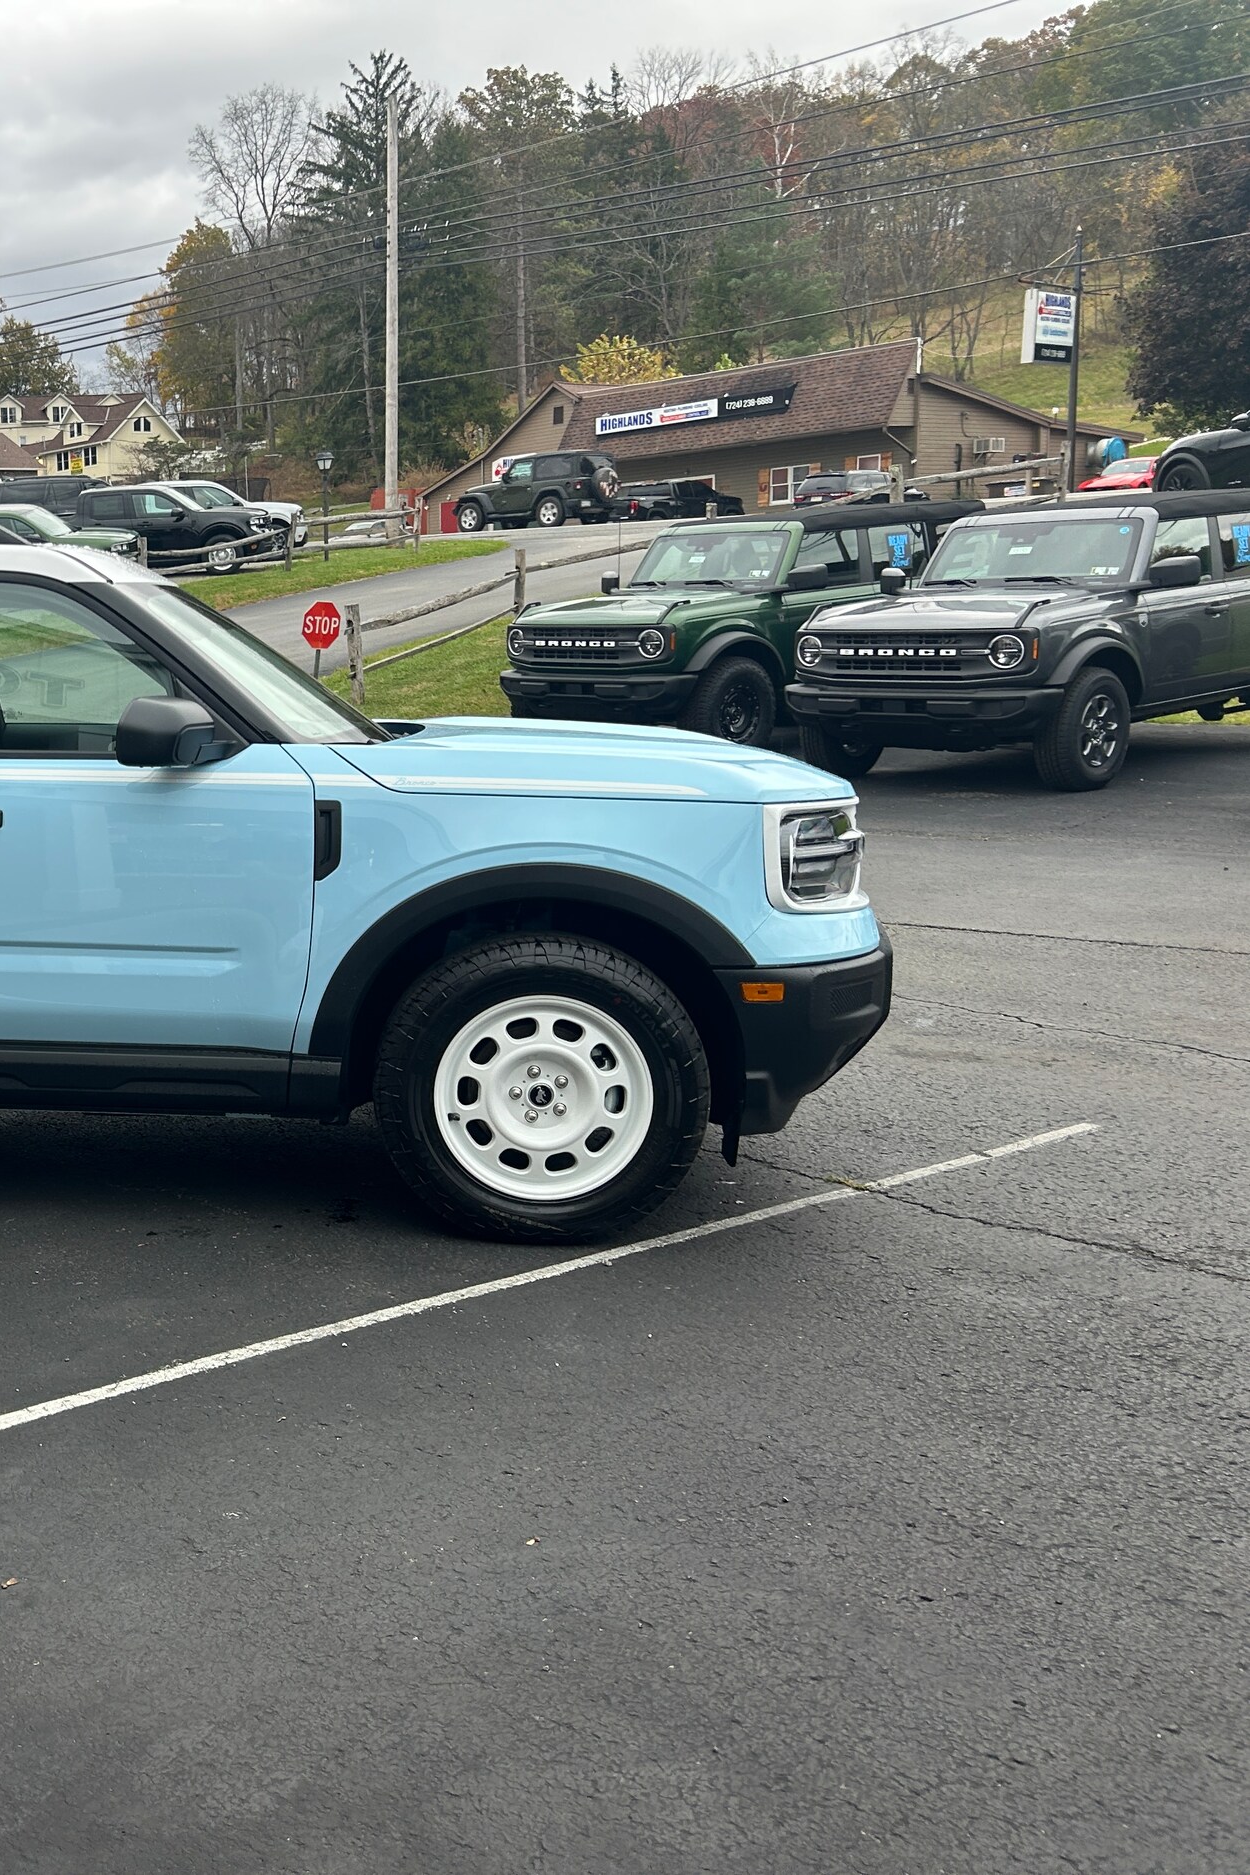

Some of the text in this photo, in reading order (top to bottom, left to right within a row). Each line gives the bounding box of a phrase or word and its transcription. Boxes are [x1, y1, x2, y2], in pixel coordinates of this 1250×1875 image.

[600, 412, 653, 432] HIGHLANDS
[304, 615, 340, 635] STOP
[839, 648, 957, 656] BRONCO
[392, 777, 437, 786] Bronco
